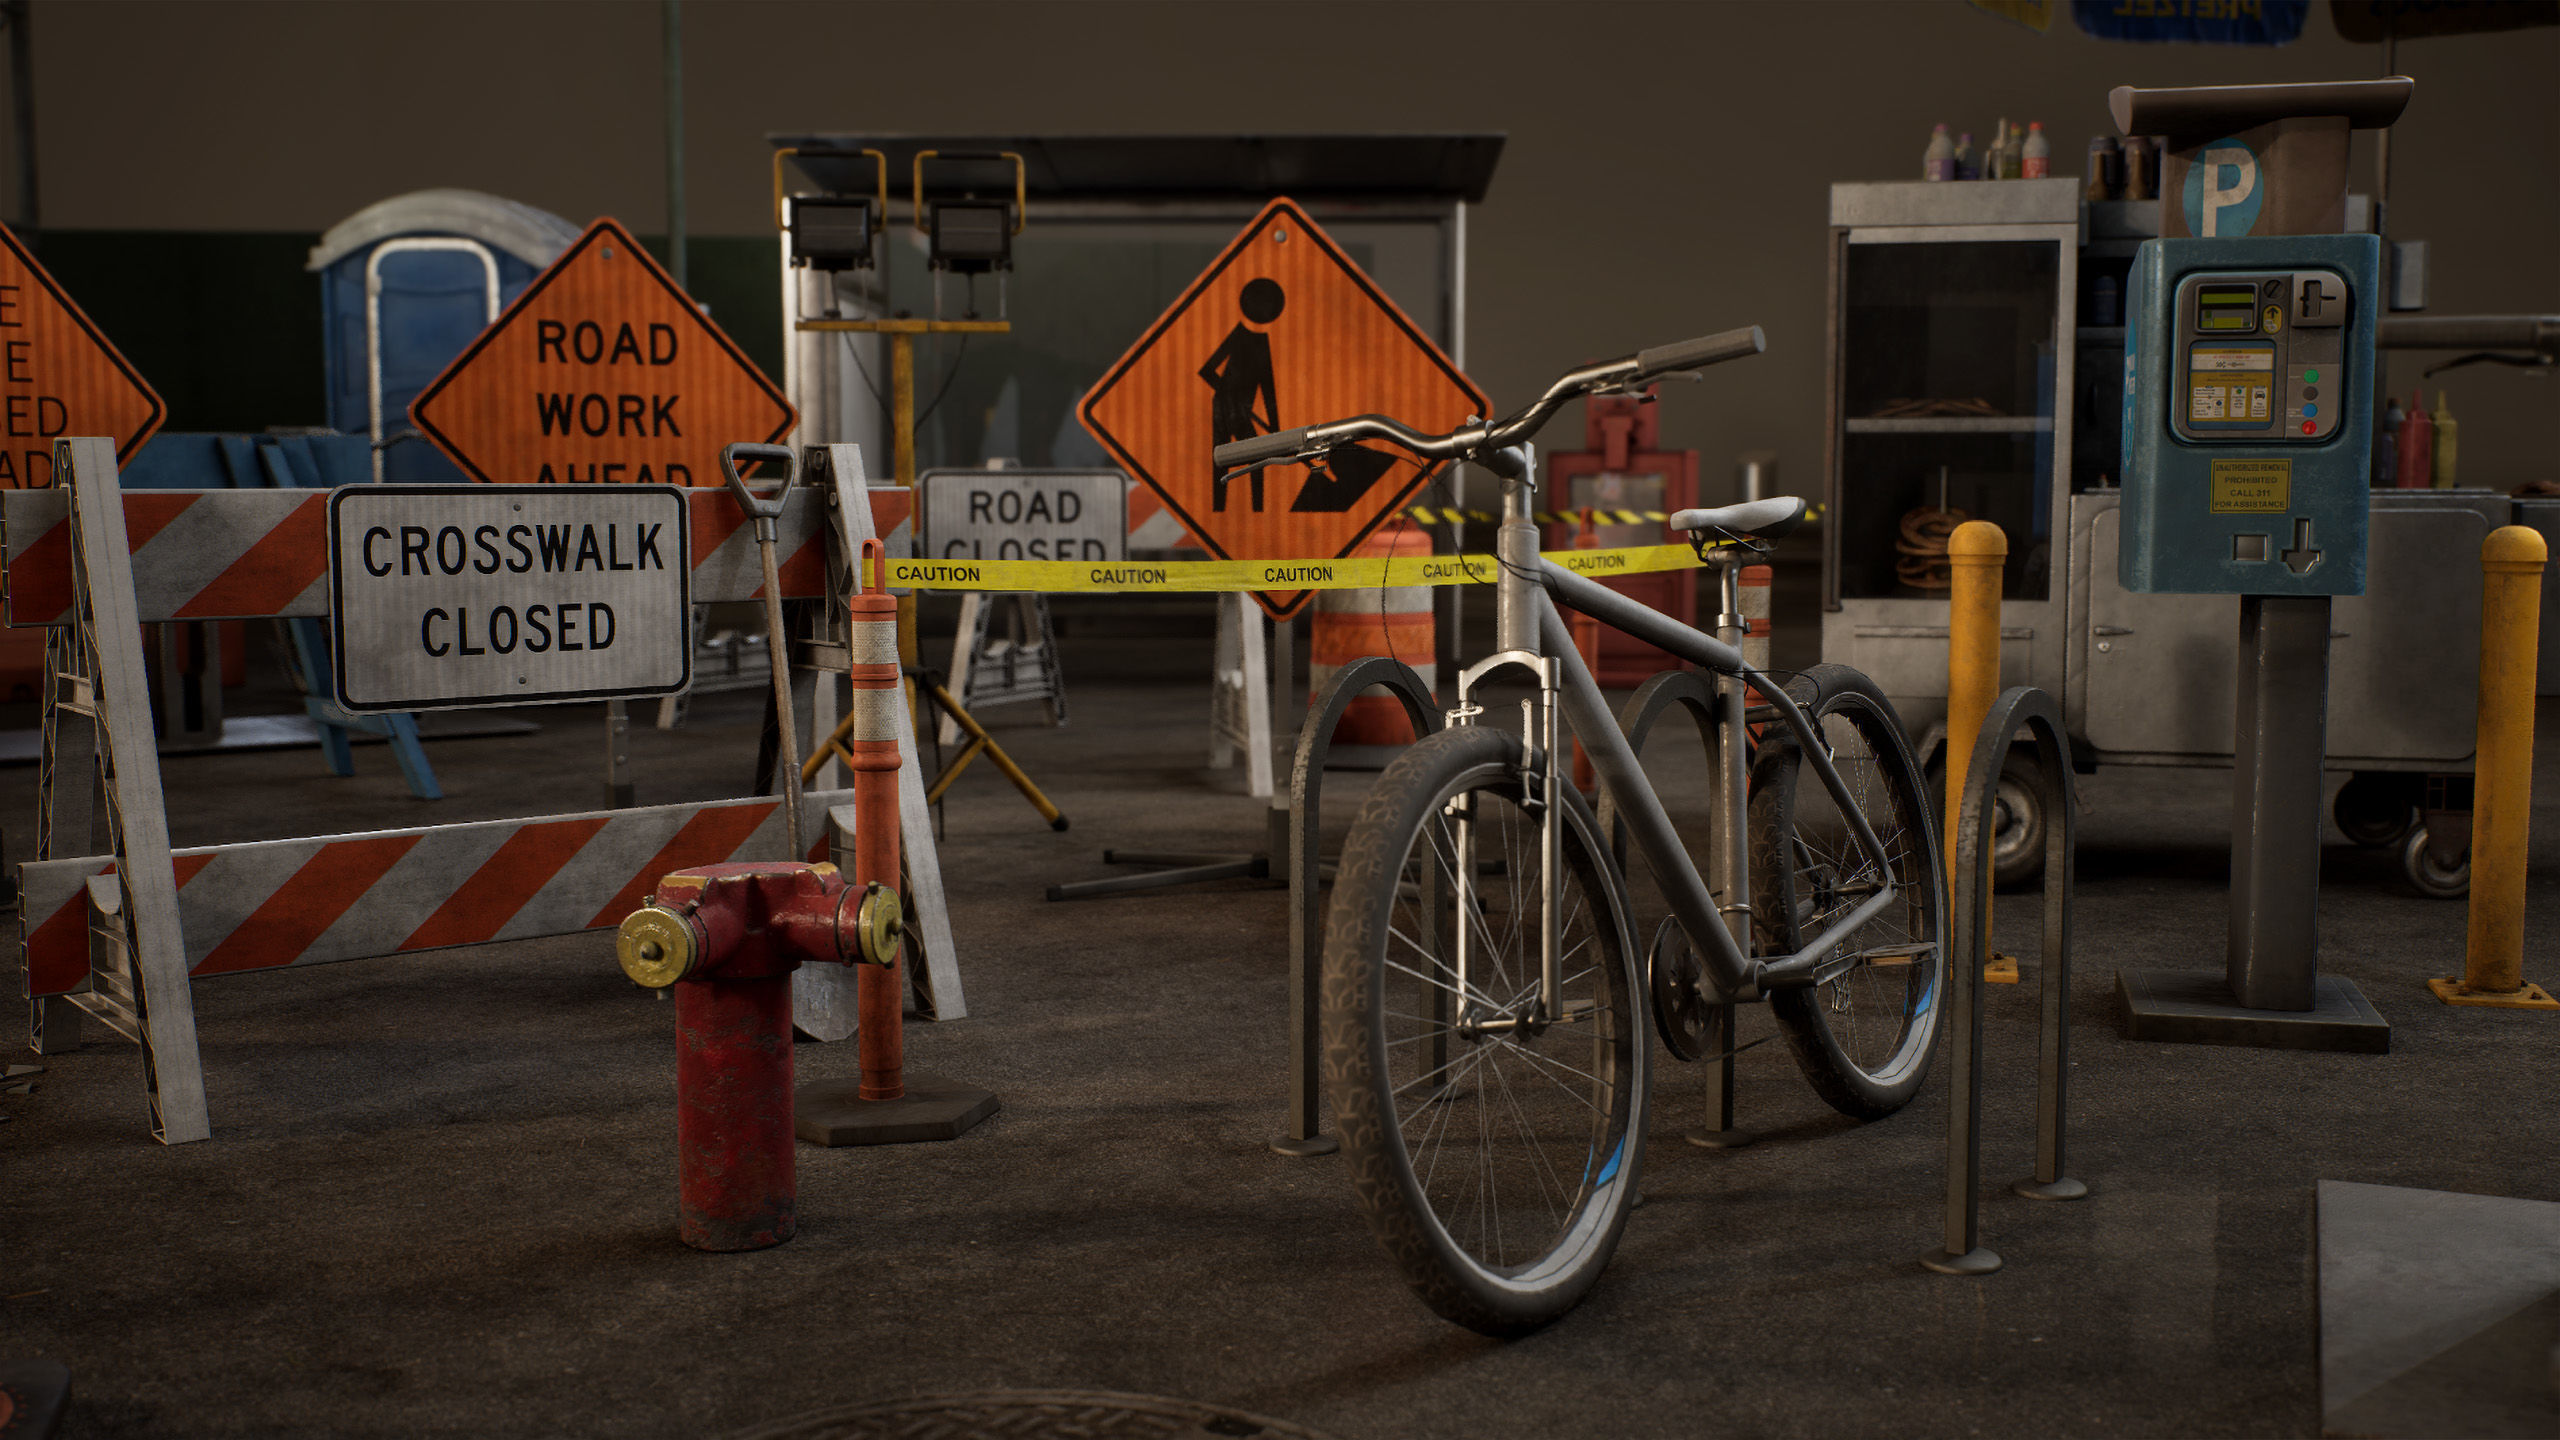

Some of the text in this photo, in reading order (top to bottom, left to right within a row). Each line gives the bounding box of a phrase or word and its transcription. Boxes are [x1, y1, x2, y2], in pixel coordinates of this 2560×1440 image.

[2201, 147, 2256, 238] P
[537, 320, 678, 365] ROAD
[536, 393, 681, 437] WORK
[969, 489, 1082, 524] ROAD
[2230, 489, 2271, 497] CALL 311
[363, 523, 665, 578] CROSSWALK
[896, 554, 1626, 585] CAUTION CAUTION CAUTION CAUTION CAUTION
[421, 602, 616, 657] CLOSED
